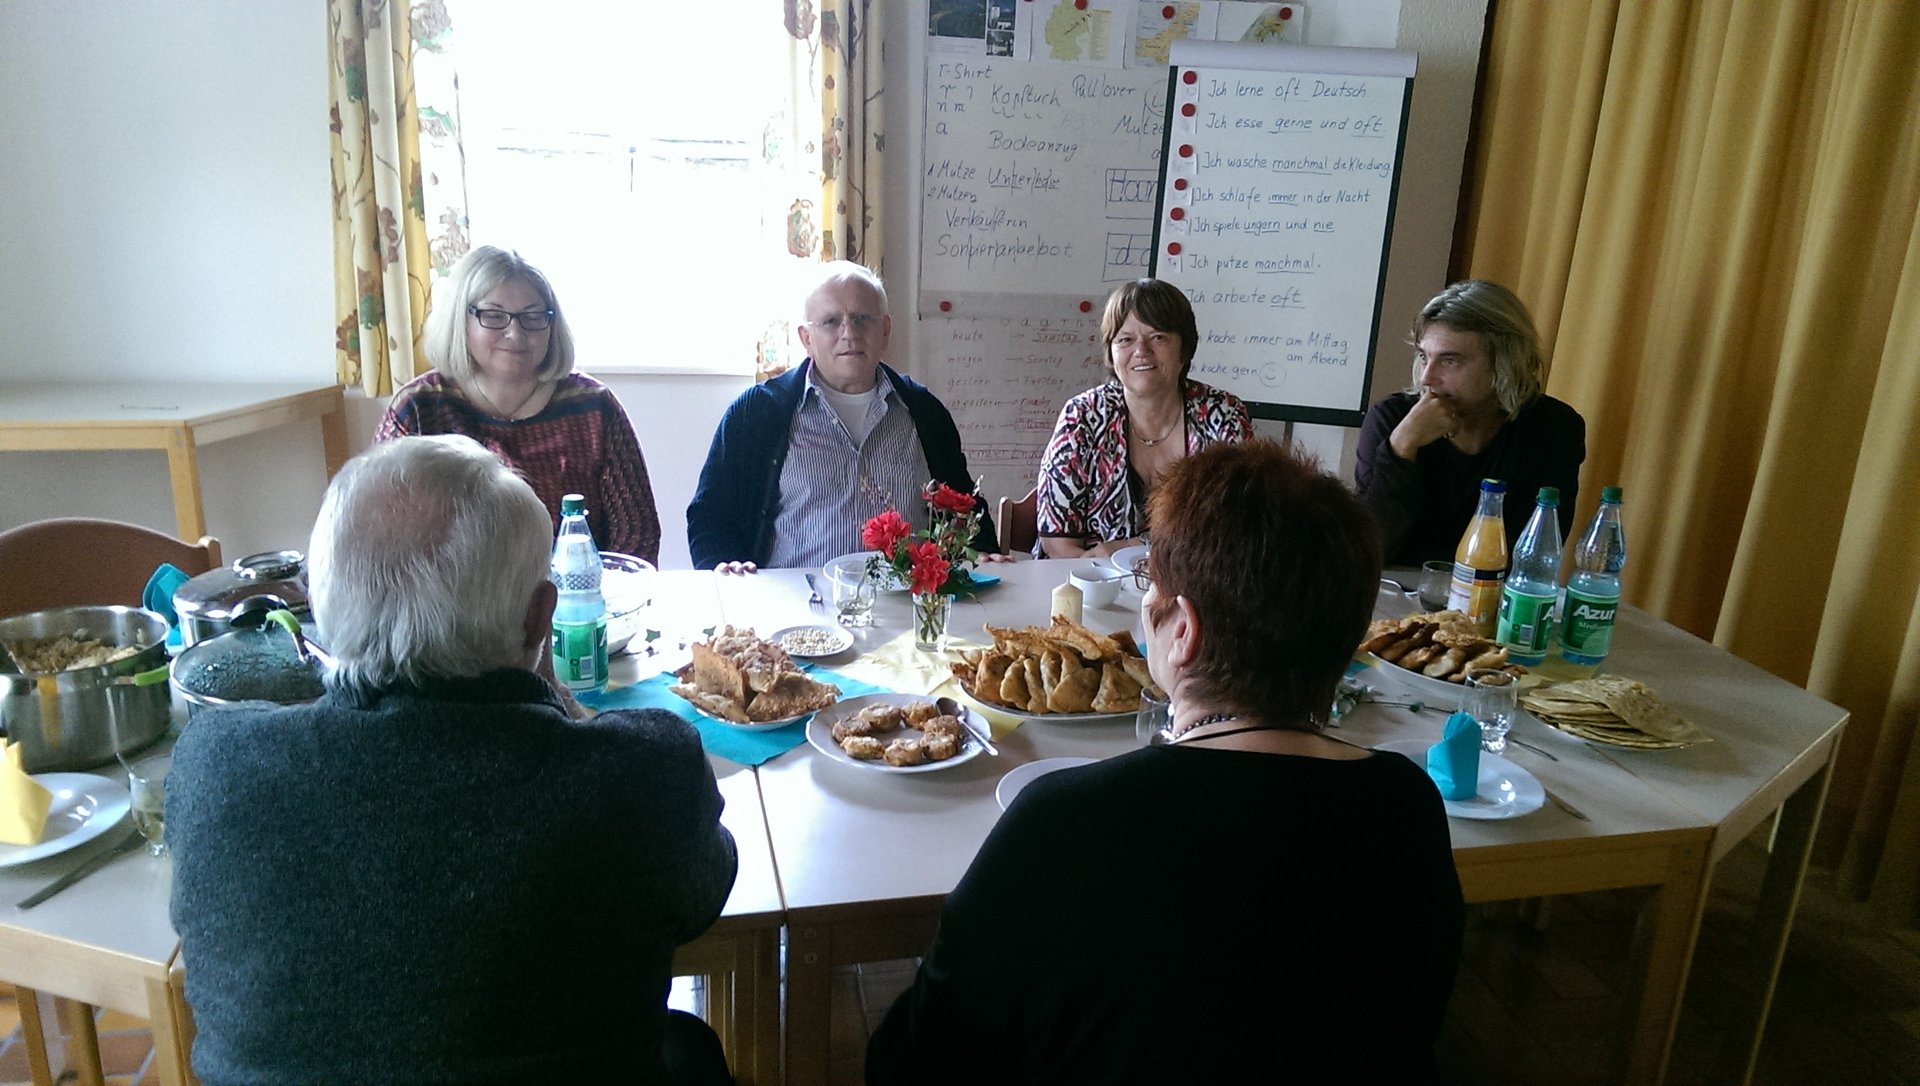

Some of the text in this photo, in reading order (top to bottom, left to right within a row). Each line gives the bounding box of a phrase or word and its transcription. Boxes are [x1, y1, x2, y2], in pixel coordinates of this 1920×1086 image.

[938, 63, 993, 80] T-Shirt
[1207, 77, 1367, 102] Ich lerne oft Deutsch
[1205, 112, 1385, 135] Ich esse gerne und oft
[987, 129, 1079, 161] Badeanzug
[1202, 151, 1222, 169] Ich
[1227, 152, 1267, 169] wasche
[1272, 153, 1329, 171] manchmal
[1333, 157, 1347, 170] die
[1193, 187, 1371, 210] Ich schlafe immer in der Nacht
[1193, 216, 1335, 237] Ich spiele ungern und nie
[1189, 253, 1209, 269] Ich
[1216, 254, 1250, 276] putze
[1186, 285, 1304, 309] Ich arbeite oft
[1206, 330, 1236, 345] koche
[1243, 333, 1283, 346] immer
[1285, 338, 1303, 348] am
[1308, 331, 1348, 354] Mittag
[1286, 351, 1348, 367] am Abend
[1187, 362, 1258, 380] ch koche gern
[1572, 604, 1616, 622] Azur
